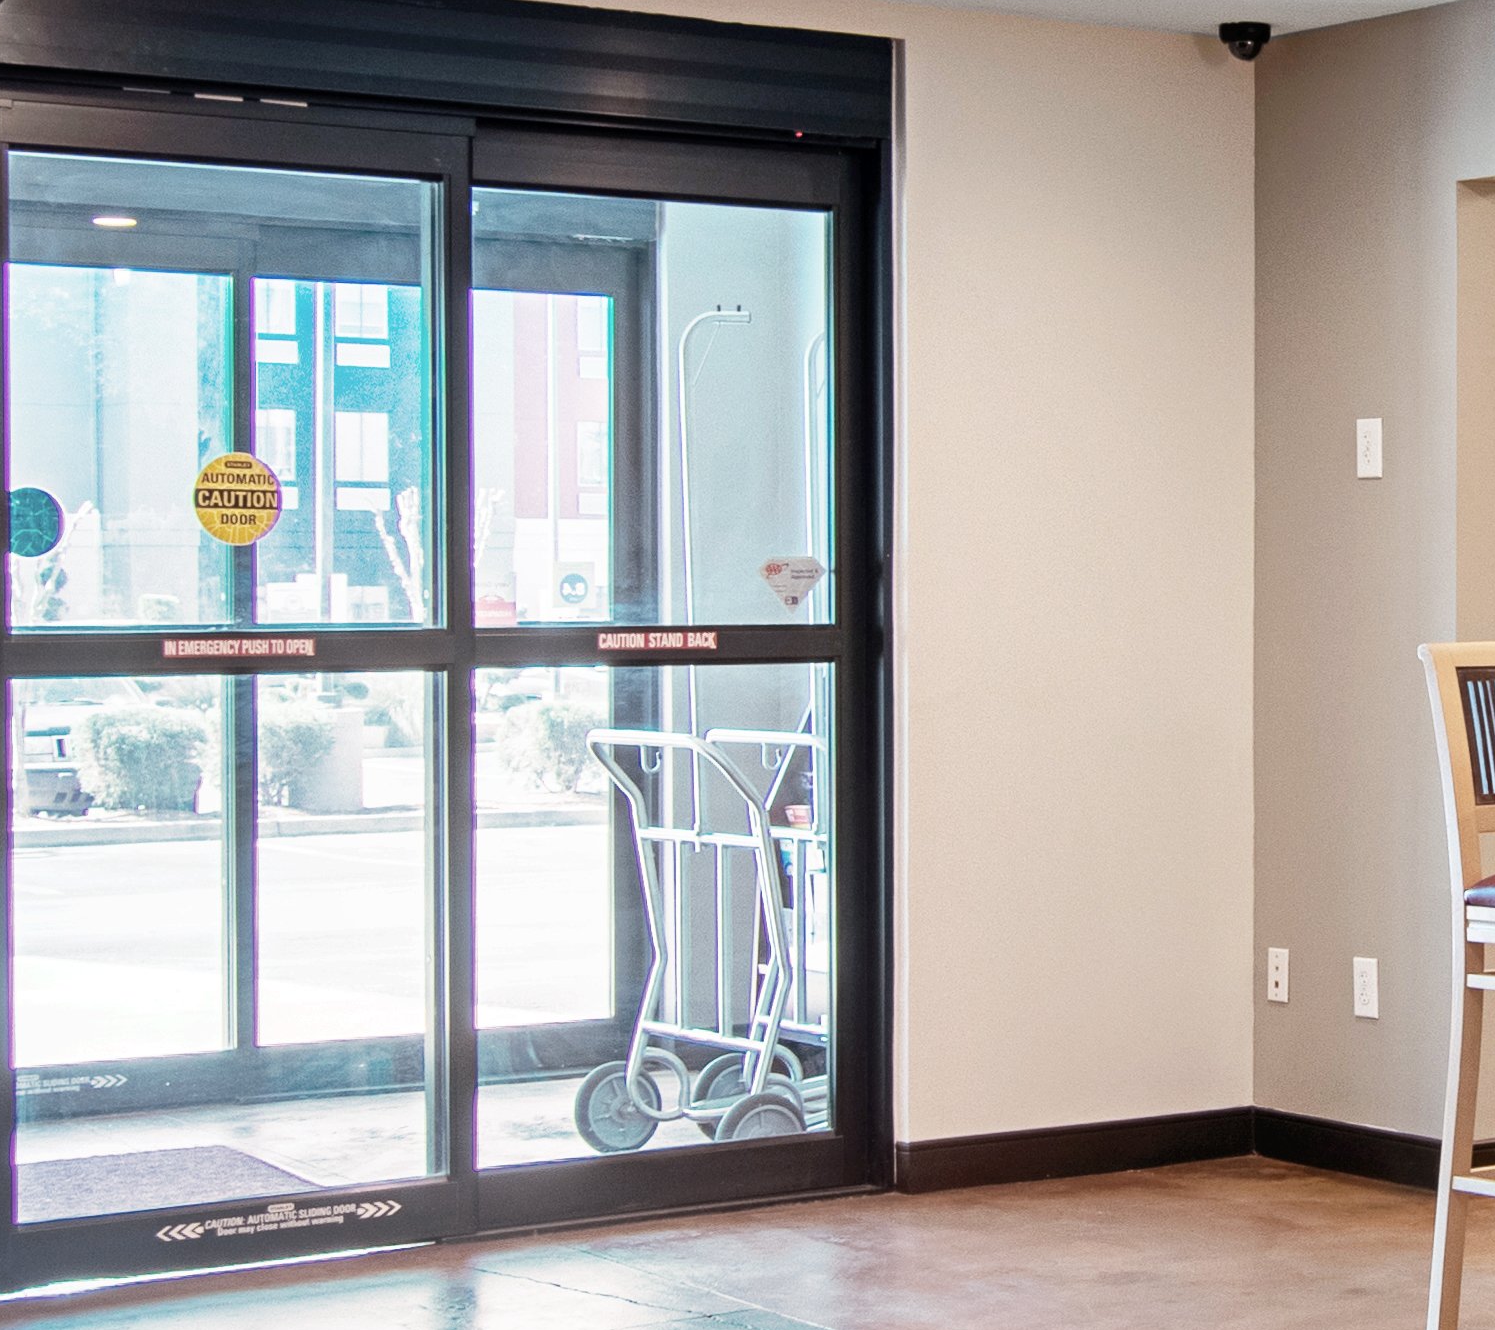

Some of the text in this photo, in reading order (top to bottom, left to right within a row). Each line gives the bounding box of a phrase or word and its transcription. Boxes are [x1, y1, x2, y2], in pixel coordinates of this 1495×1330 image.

[201, 473, 274, 485] AUTOMATIC
[198, 490, 278, 507] CAUTION
[220, 514, 256, 525] DOOR
[164, 639, 314, 655] IN EMERGENCY PUSH TO OPEN
[599, 632, 716, 648] CAUTION STAND BACK
[247, 1210, 298, 1225] AUTOMATIC
[298, 1206, 332, 1218] SLIDING
[333, 1203, 357, 1215] DOOR
